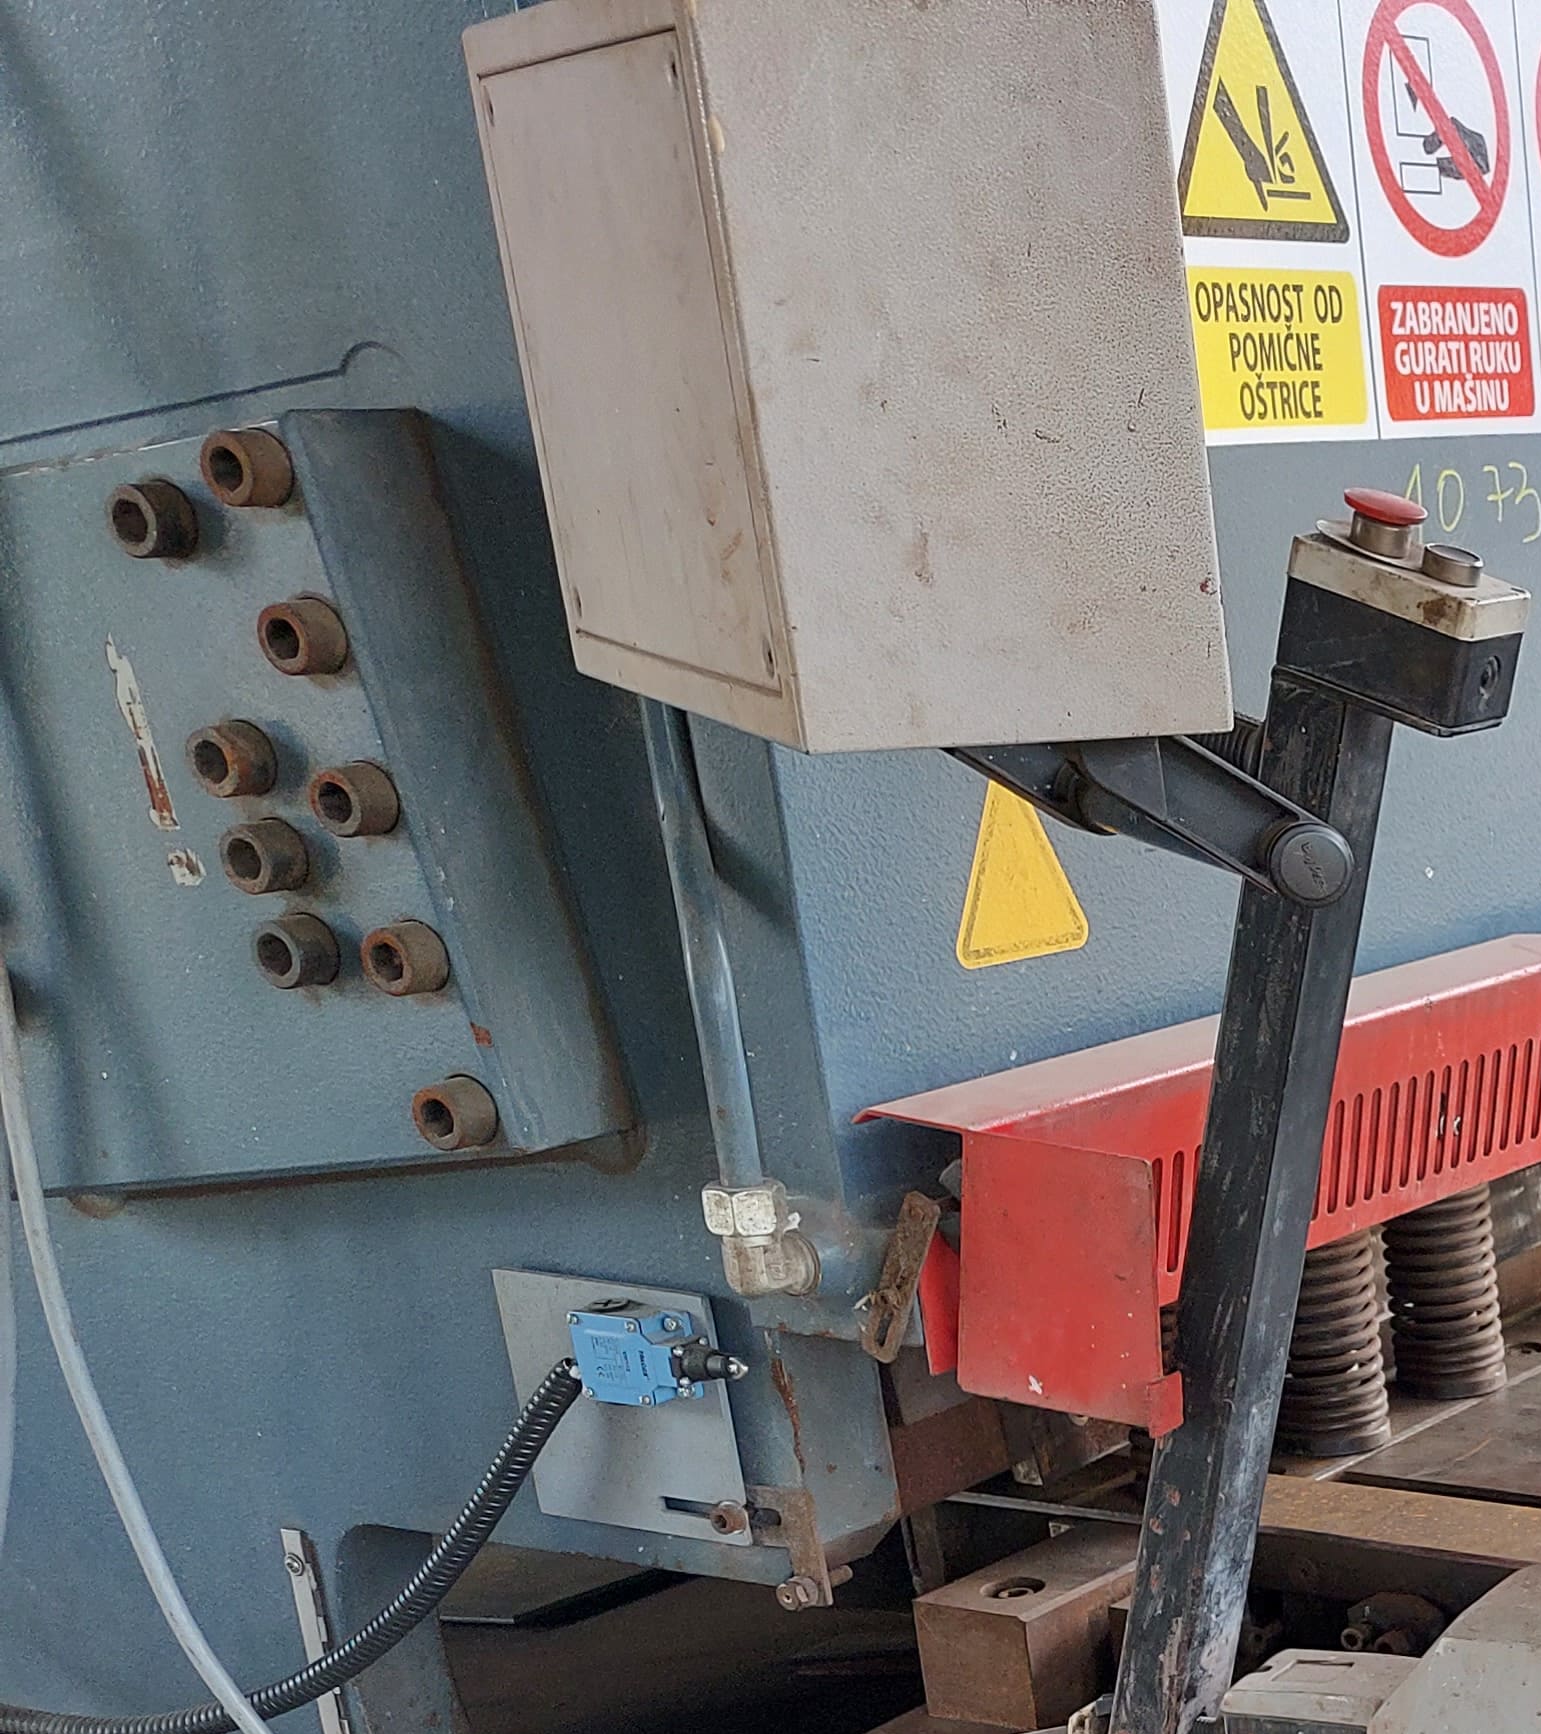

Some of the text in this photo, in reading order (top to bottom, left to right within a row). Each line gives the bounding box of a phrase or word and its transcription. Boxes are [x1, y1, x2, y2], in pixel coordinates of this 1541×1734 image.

[1195, 281, 1343, 323] OPASNOST OD
[1390, 301, 1519, 336] ZABRANJENO
[1229, 324, 1324, 372] POMIČNE
[1394, 340, 1522, 375] GURATI RUKU
[1240, 373, 1324, 421] OŠTRICE
[1413, 373, 1510, 414] U MAŠINU
